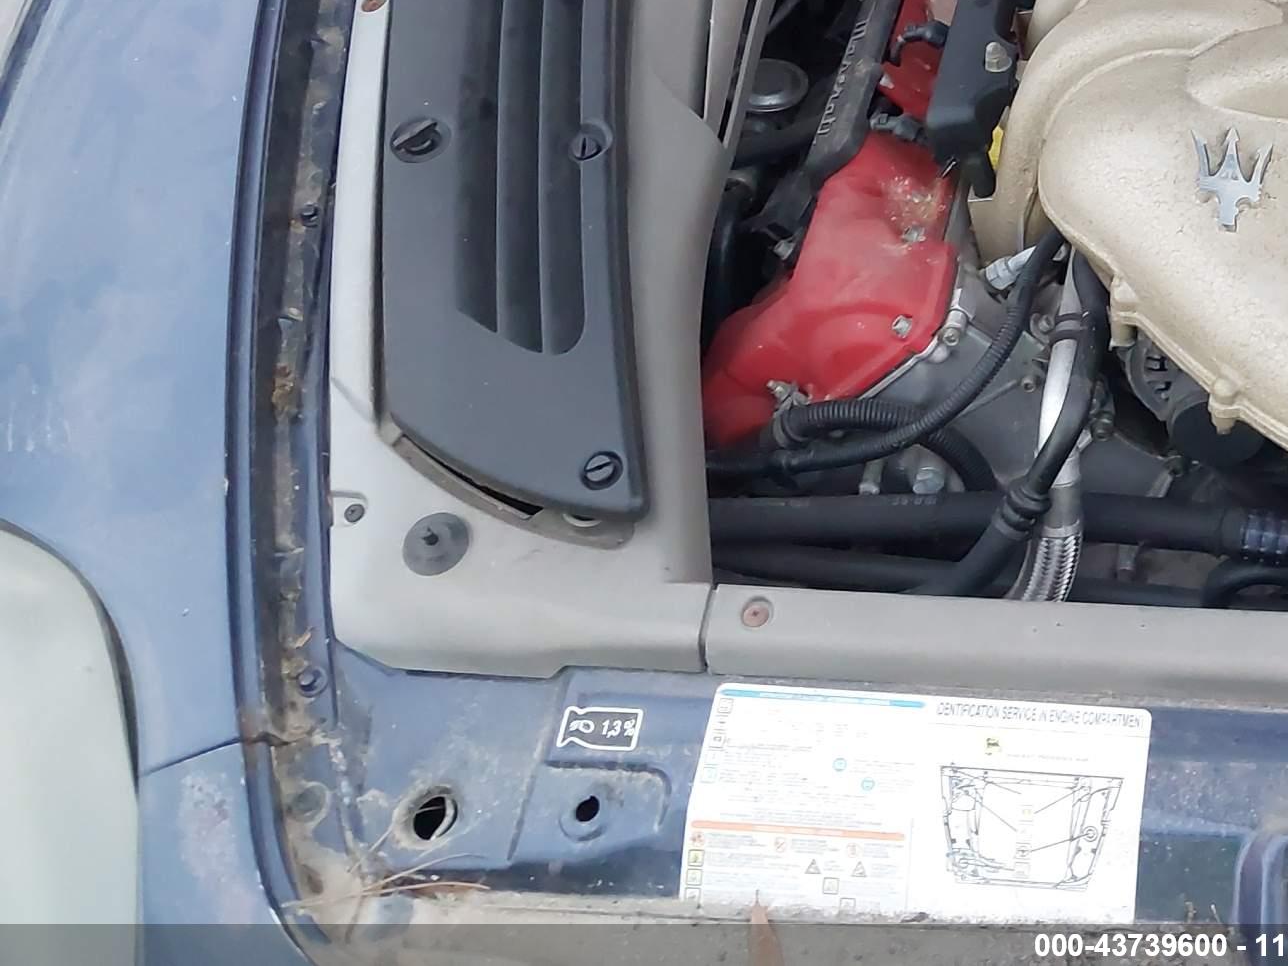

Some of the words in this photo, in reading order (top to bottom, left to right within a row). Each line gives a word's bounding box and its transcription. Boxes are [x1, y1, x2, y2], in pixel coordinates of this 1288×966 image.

[1002, 705, 1037, 722] SERVICE
[1038, 708, 1048, 723] IN
[1049, 709, 1081, 725] ENGINE
[1082, 711, 1144, 729] COMPARTMENT
